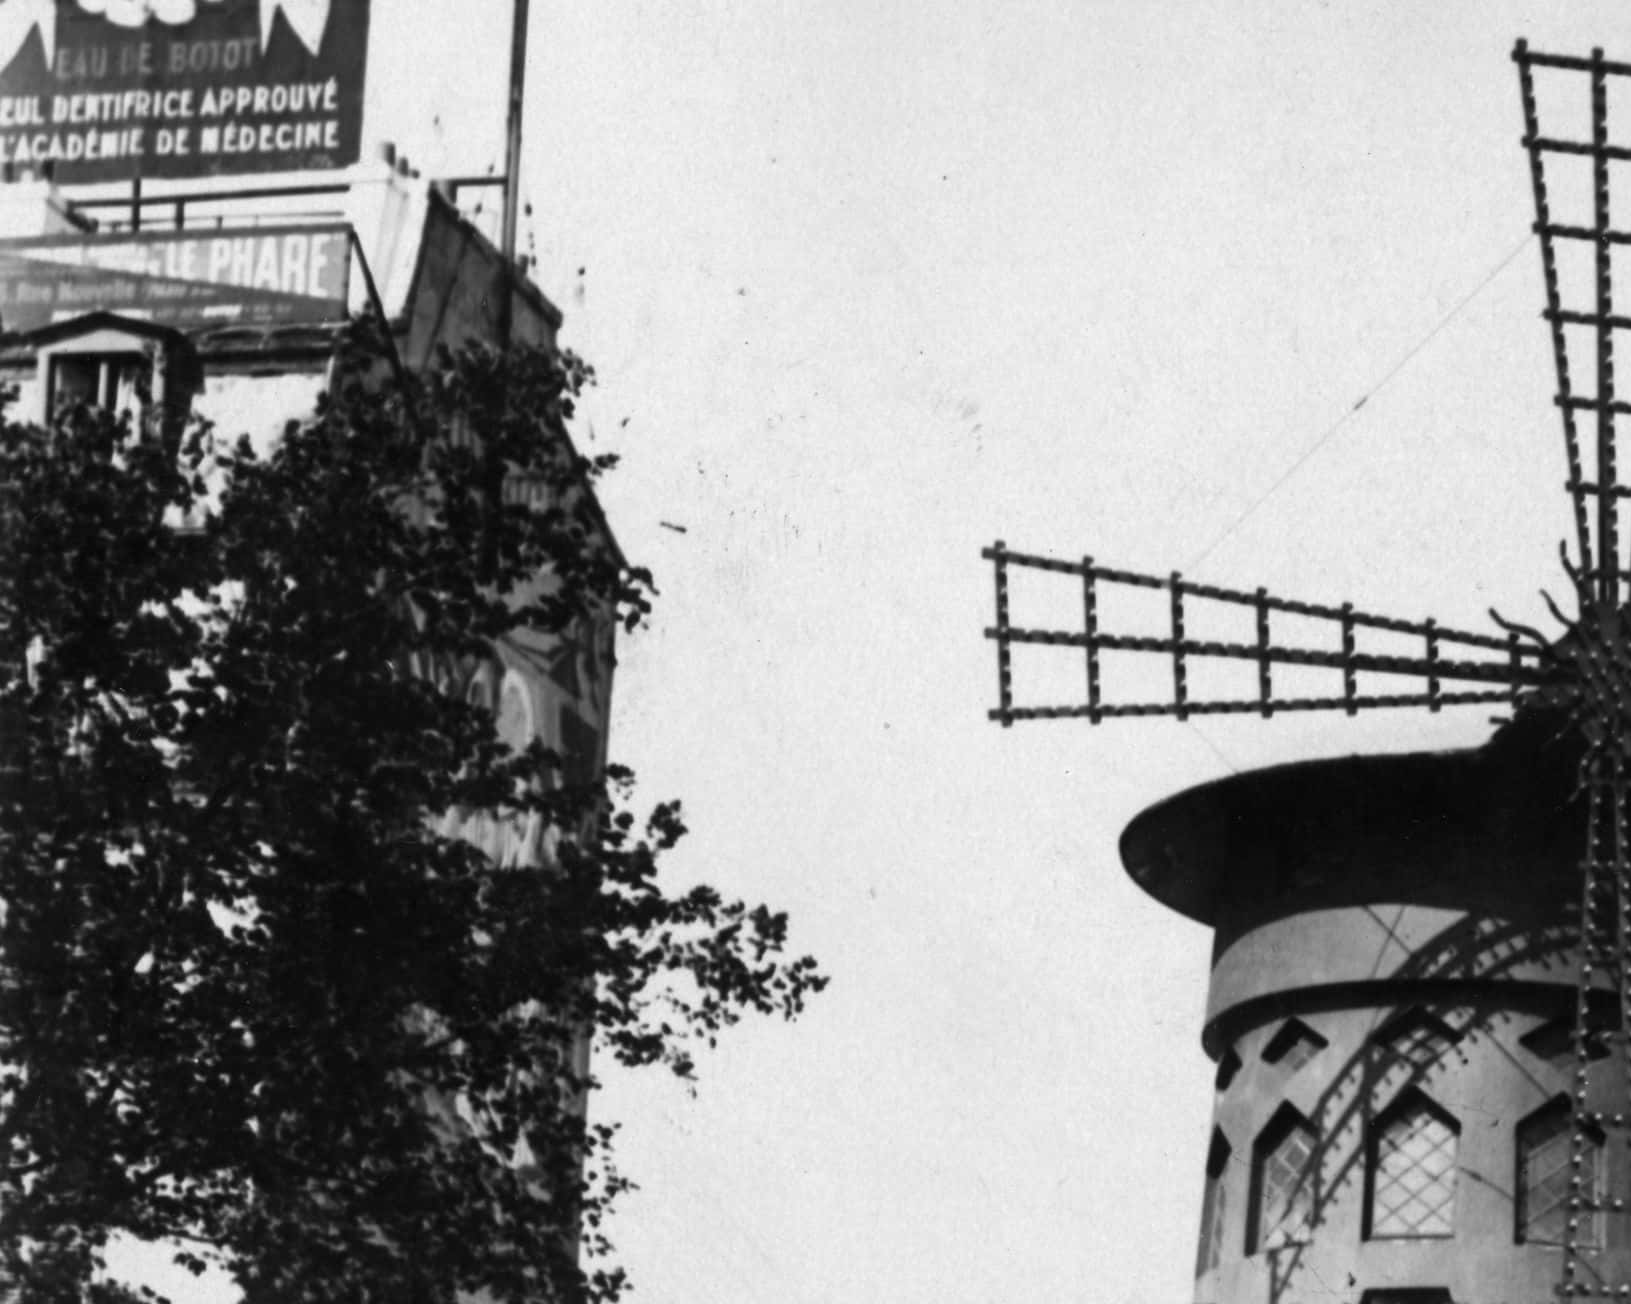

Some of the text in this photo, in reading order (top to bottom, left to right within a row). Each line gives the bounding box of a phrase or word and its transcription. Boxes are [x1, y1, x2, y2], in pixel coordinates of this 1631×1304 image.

[52, 88, 194, 124] DENTIFRICE
[199, 76, 339, 116] APPROUVÉ
[155, 127, 190, 155] DE
[200, 117, 340, 154] MÉDECINE
[207, 233, 329, 299] PHARE
